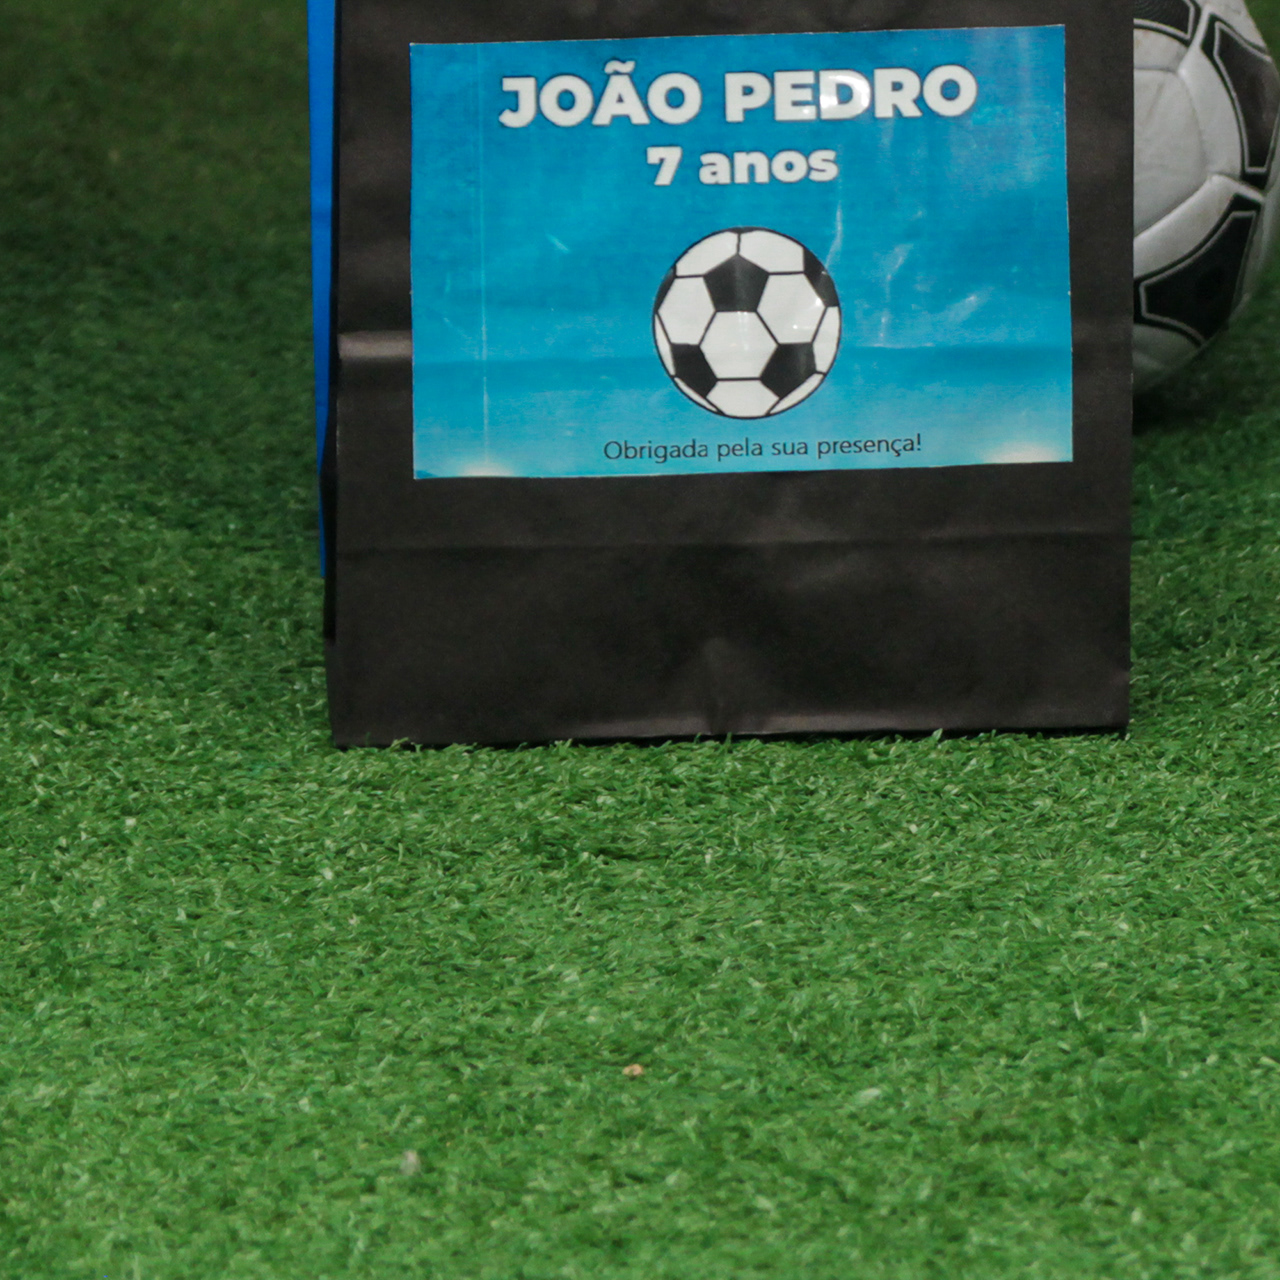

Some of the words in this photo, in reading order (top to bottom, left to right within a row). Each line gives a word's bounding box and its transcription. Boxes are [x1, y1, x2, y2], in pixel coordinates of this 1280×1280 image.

[498, 60, 702, 128] JOÃO
[724, 64, 978, 122] PEDRO
[646, 146, 682, 186] 7
[698, 148, 839, 185] anos
[604, 439, 708, 463] Obrigada
[717, 437, 763, 462] pela
[771, 440, 808, 455] sua
[817, 433, 922, 458] presença!
